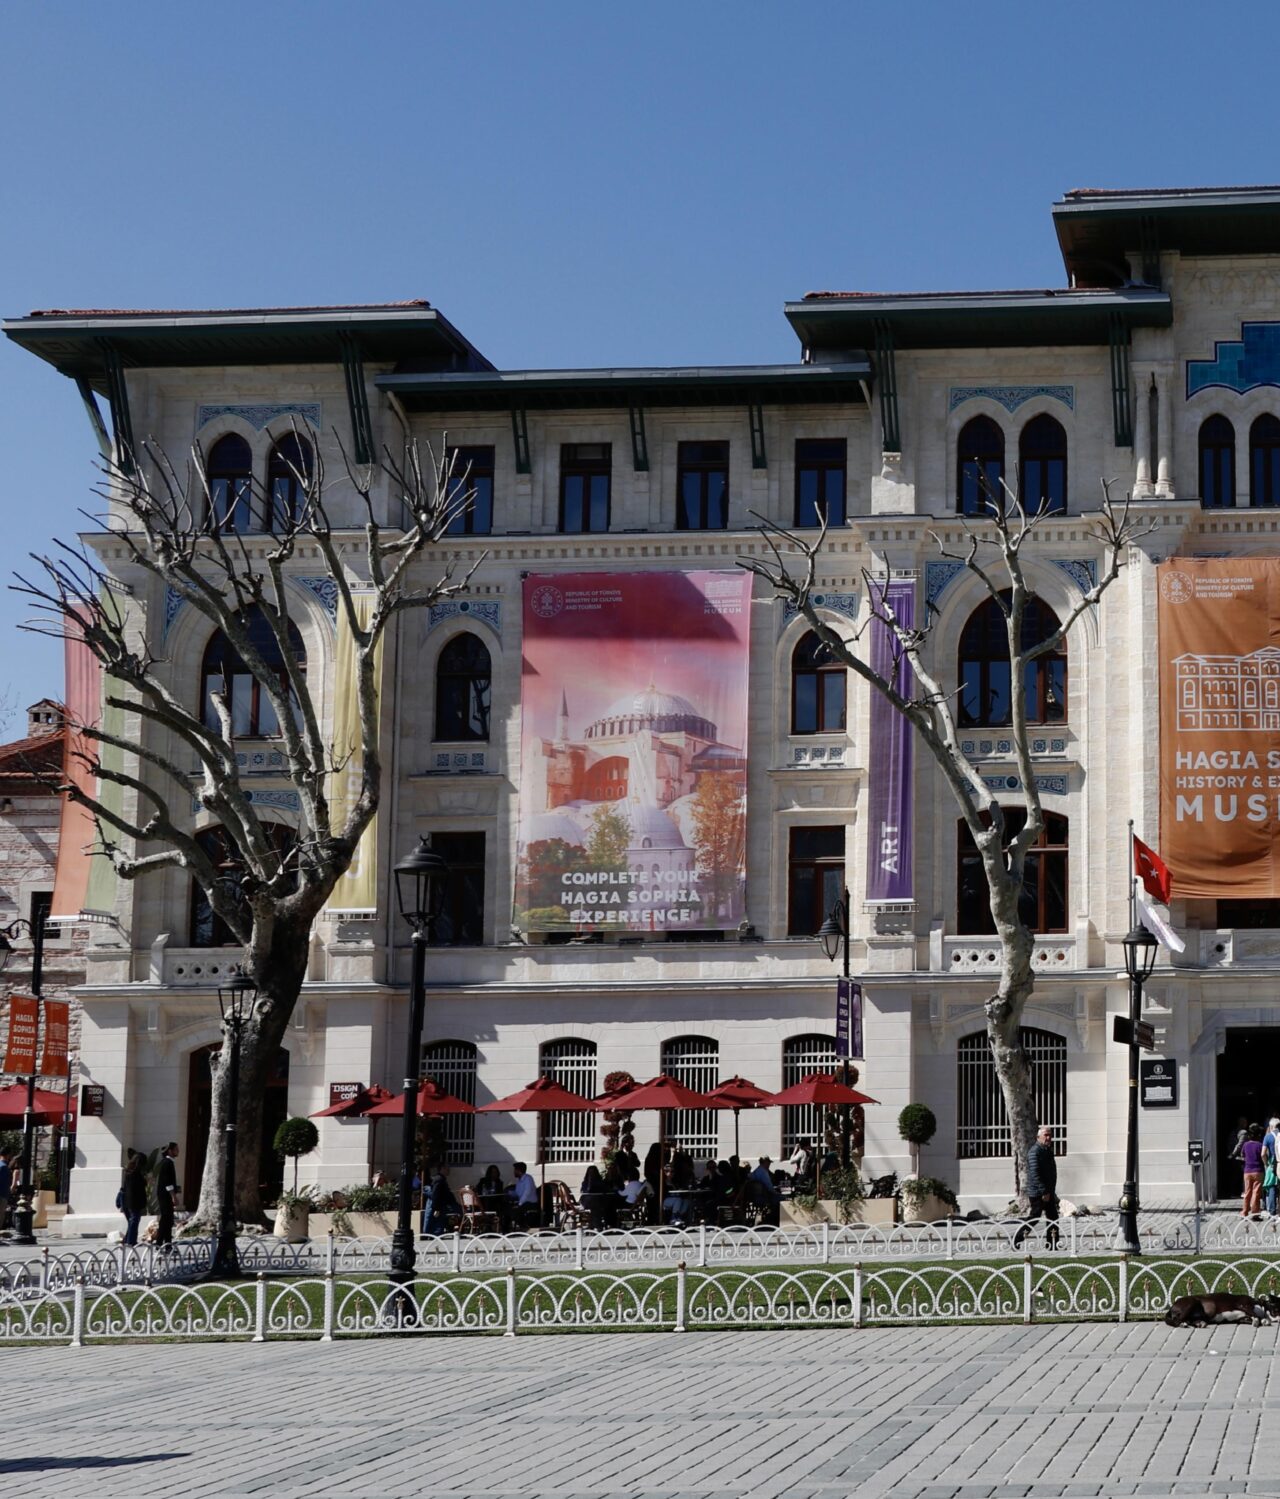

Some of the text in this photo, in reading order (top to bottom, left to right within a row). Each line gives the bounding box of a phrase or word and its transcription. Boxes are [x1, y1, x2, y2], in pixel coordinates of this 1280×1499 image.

[1176, 751, 1259, 770] HAGIA
[1176, 776, 1247, 788] HISTORY
[1252, 776, 1263, 788] &
[881, 822, 898, 874] ART
[561, 871, 700, 885] COMPLETE YOUR
[561, 890, 700, 904] HAGIA SOPHIA
[570, 909, 690, 923] EXPERIENCE
[16, 1014, 34, 1022] HAGIA
[13, 1025, 35, 1033] SOPHIA
[13, 1036, 34, 1045] TICKET
[11, 1047, 33, 1056] OFFICE
